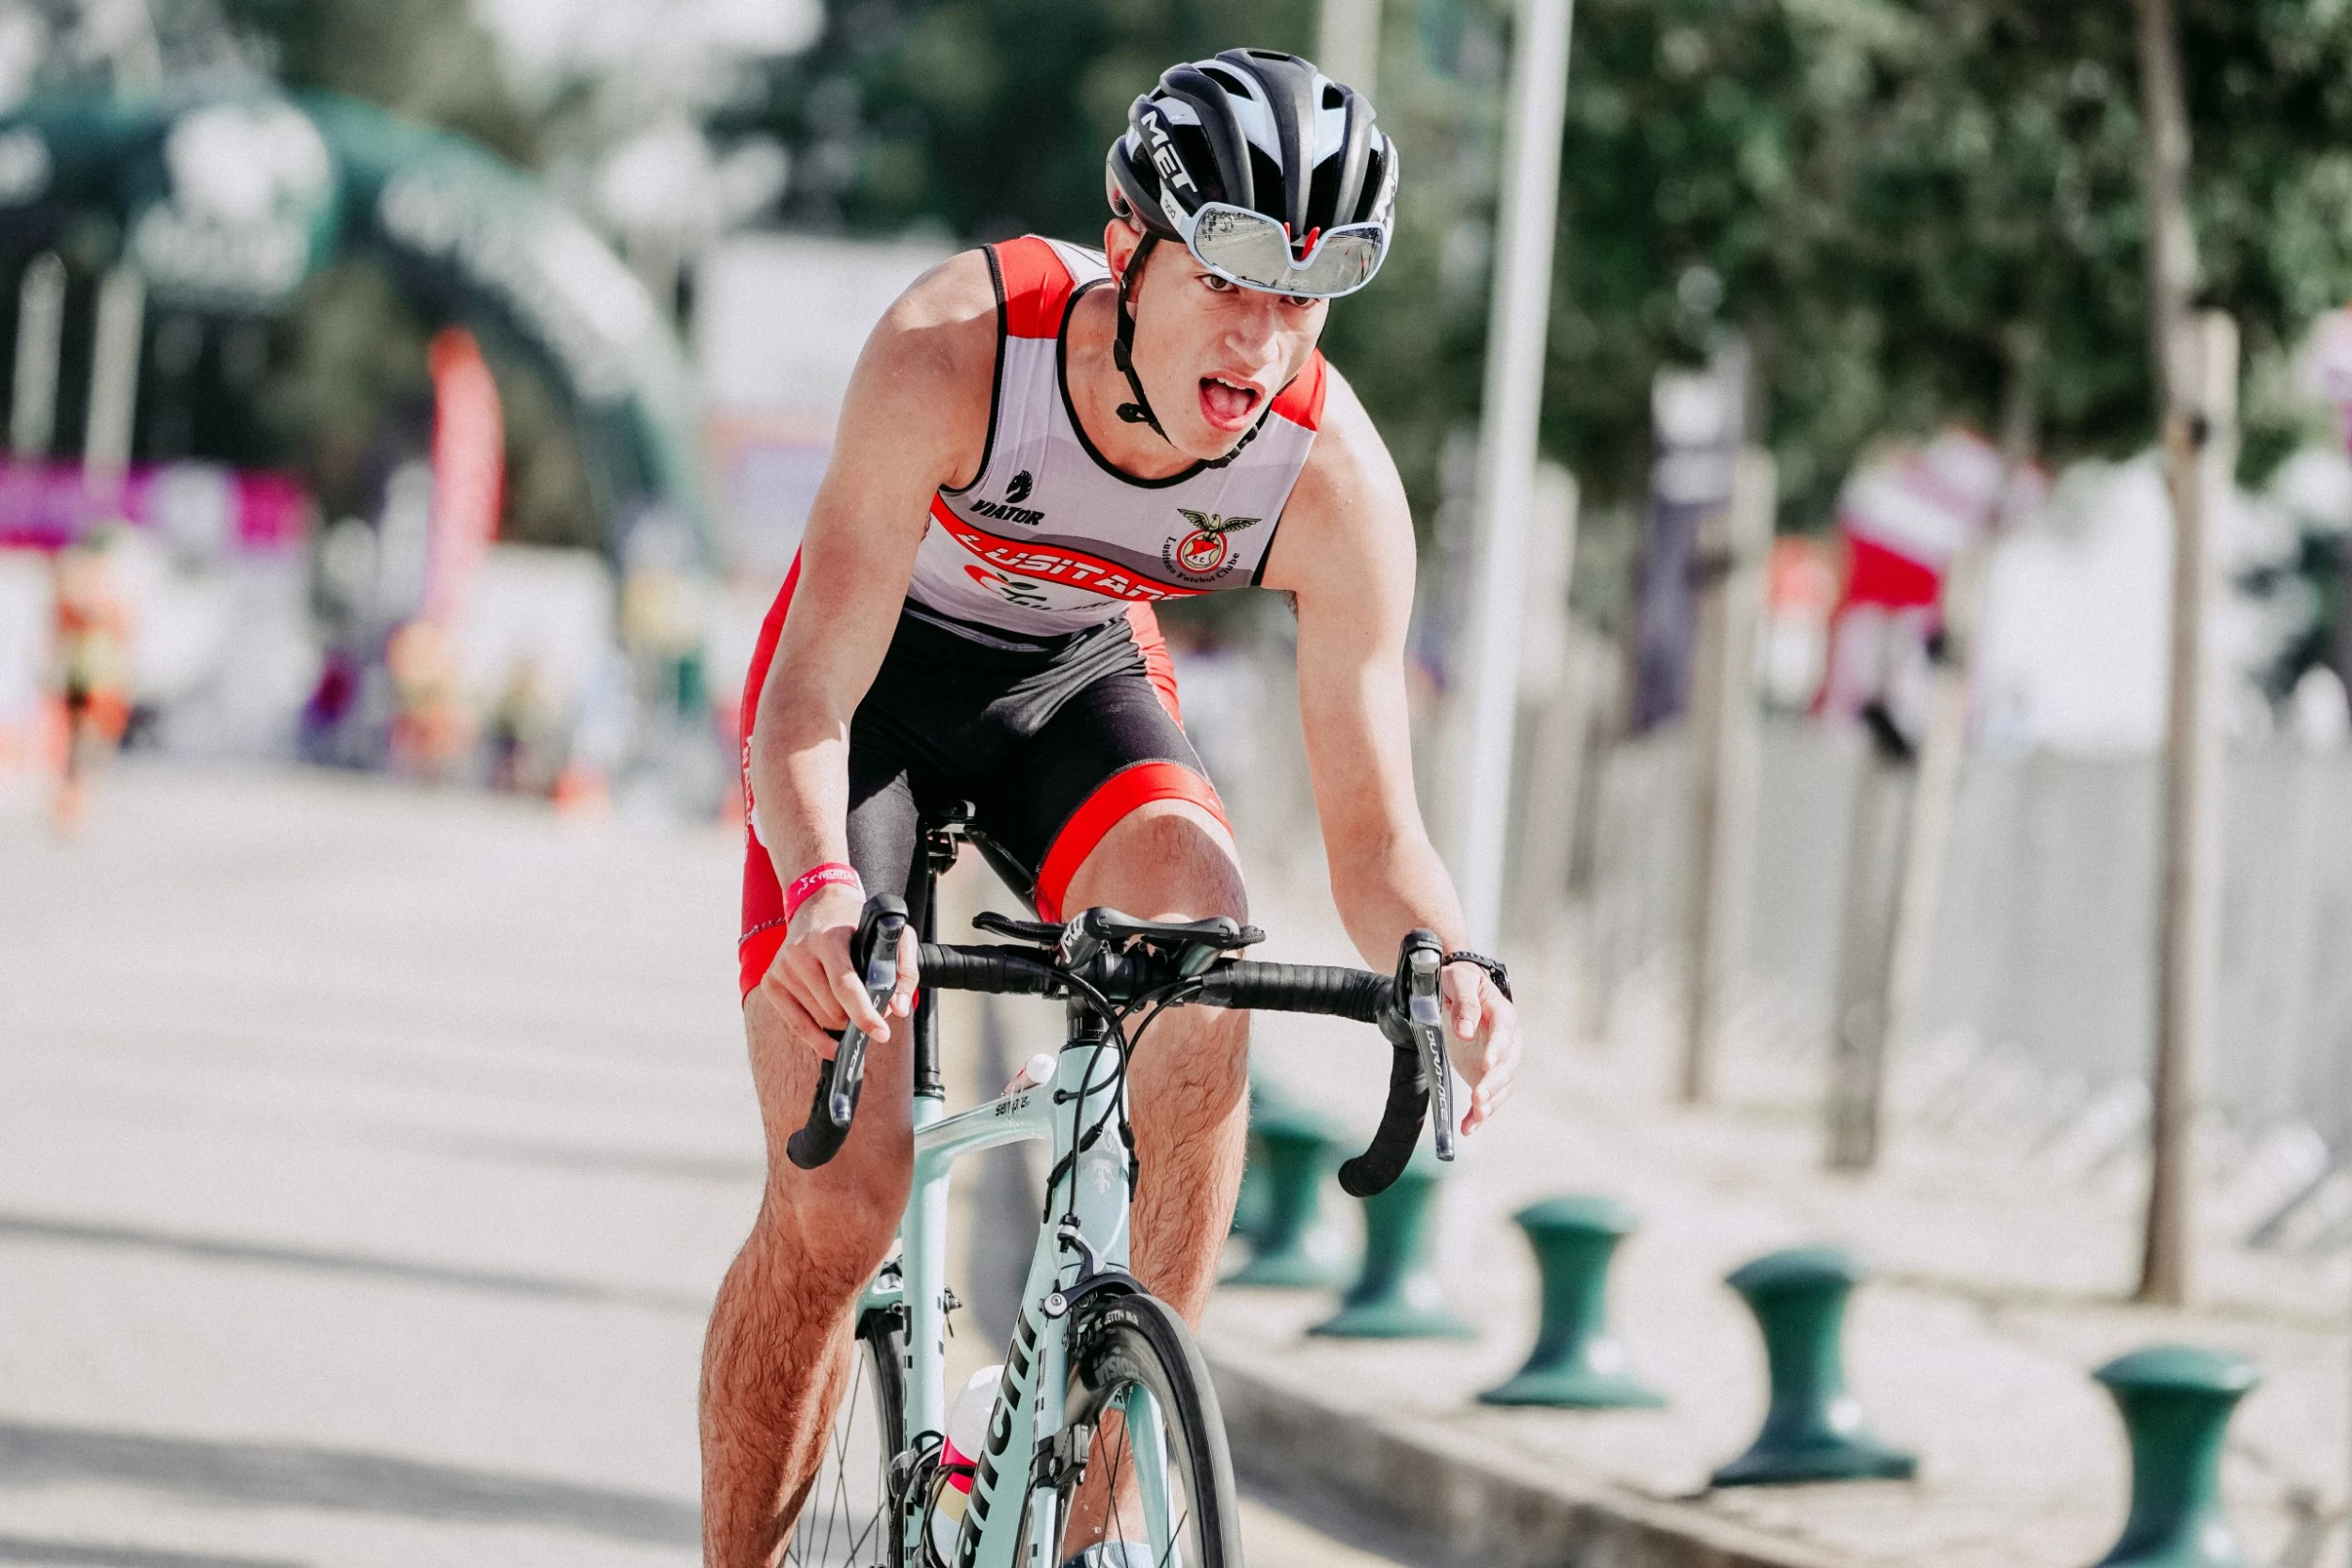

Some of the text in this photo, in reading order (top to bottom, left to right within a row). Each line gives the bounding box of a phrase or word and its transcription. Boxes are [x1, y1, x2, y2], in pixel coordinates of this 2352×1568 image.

[1140, 110, 1199, 194] MET
[969, 499, 1046, 527] VIATOR
[956, 532, 1198, 601] LUSITAN
[1176, 572, 1216, 583] Futebol
[1216, 552, 1241, 578] Clube
